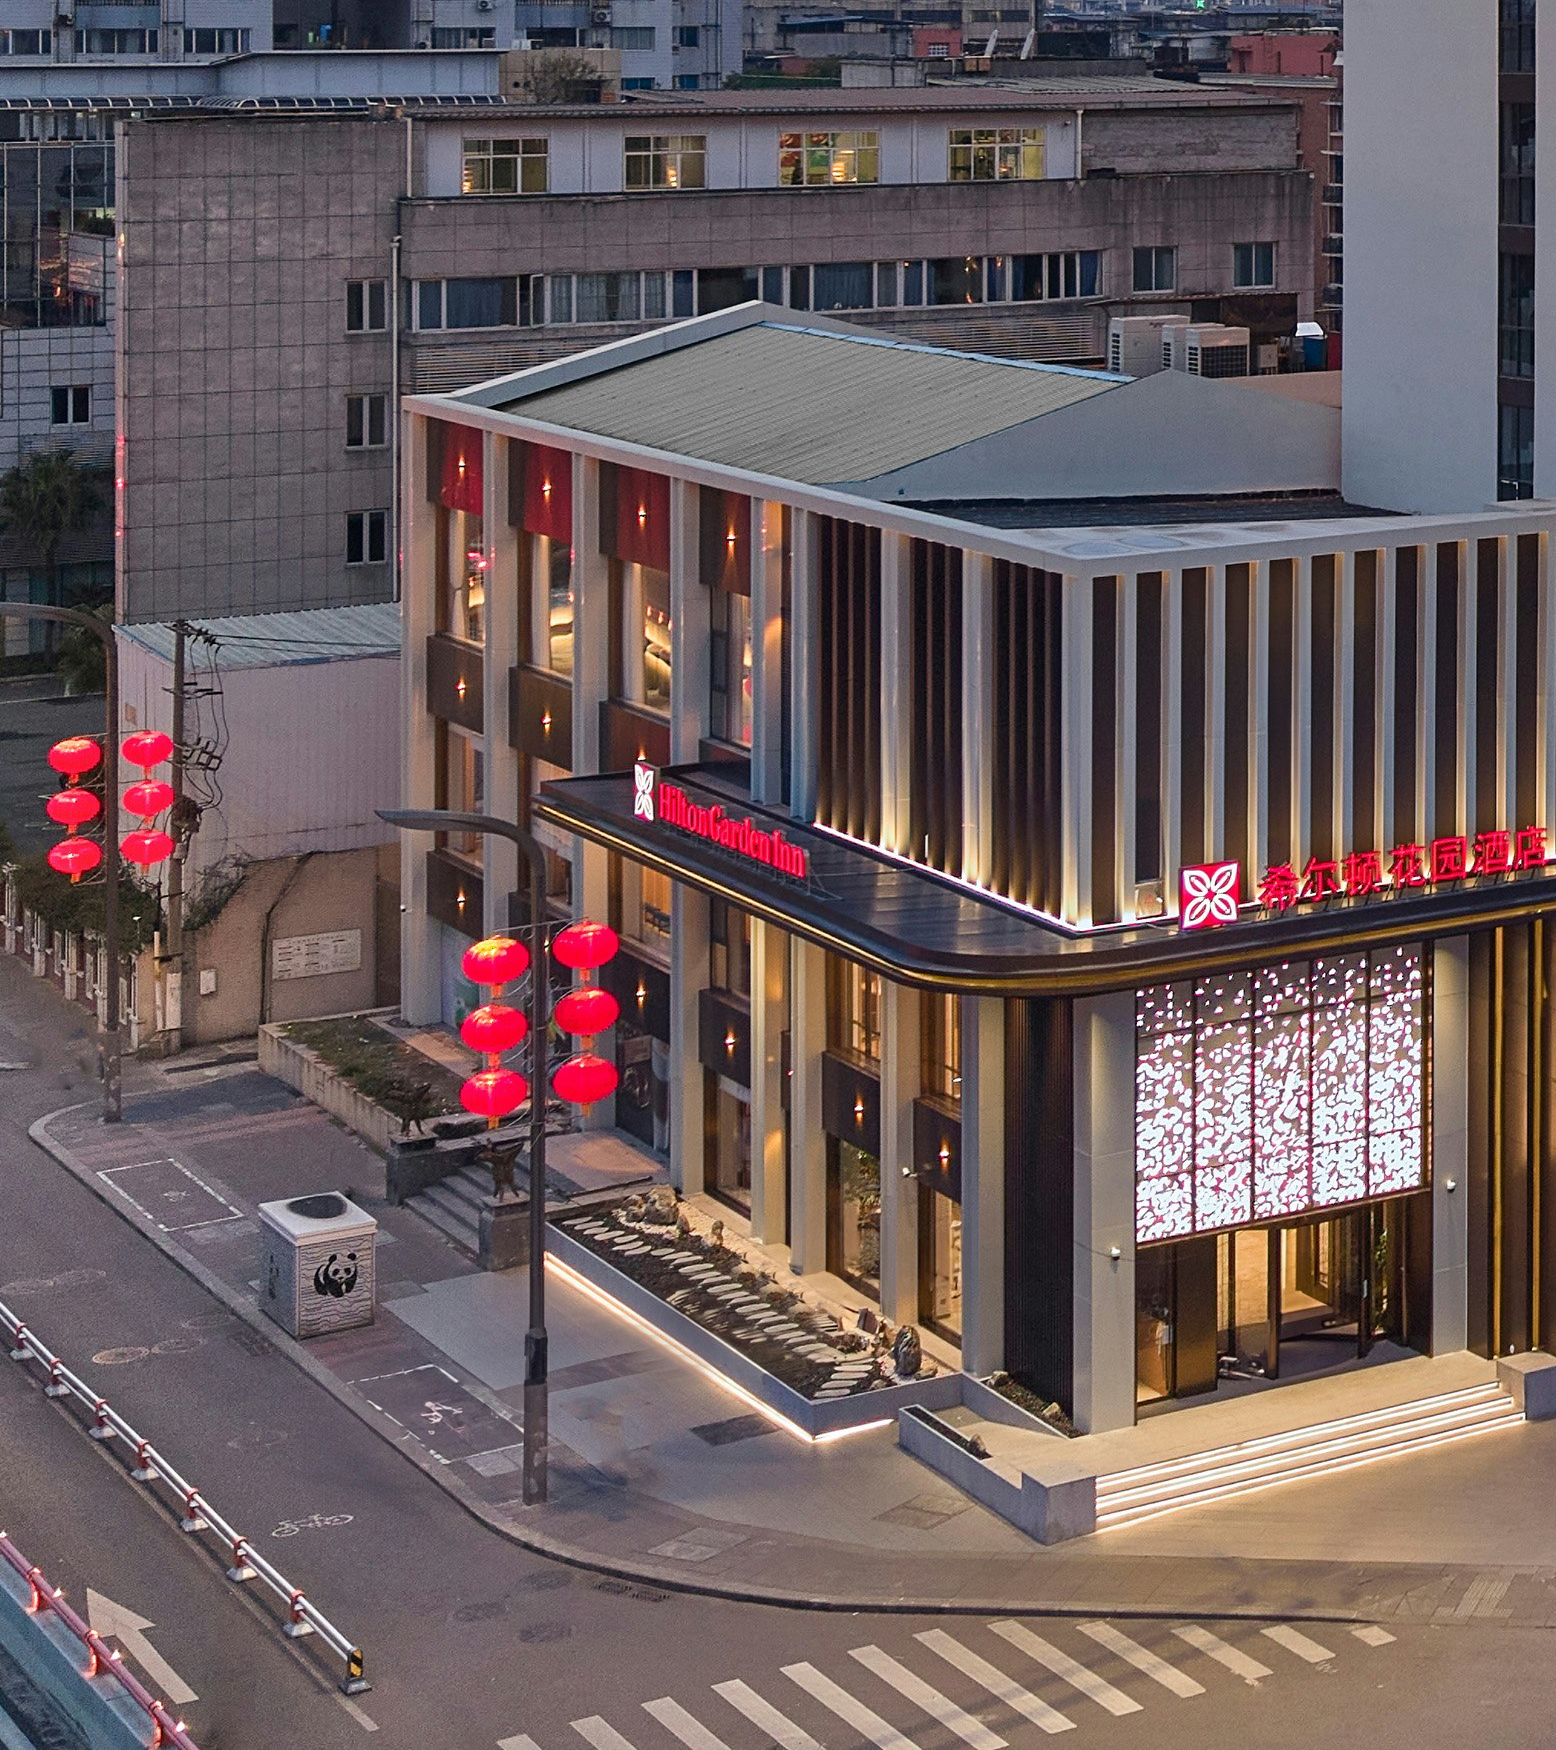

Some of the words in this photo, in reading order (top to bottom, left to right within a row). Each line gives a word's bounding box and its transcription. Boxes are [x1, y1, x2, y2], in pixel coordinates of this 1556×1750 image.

[658, 783, 708, 837] Hilton
[710, 805, 771, 865] Garden
[772, 830, 806, 879] Inn
[1258, 826, 1548, 911] 希尔顿花园酒店
